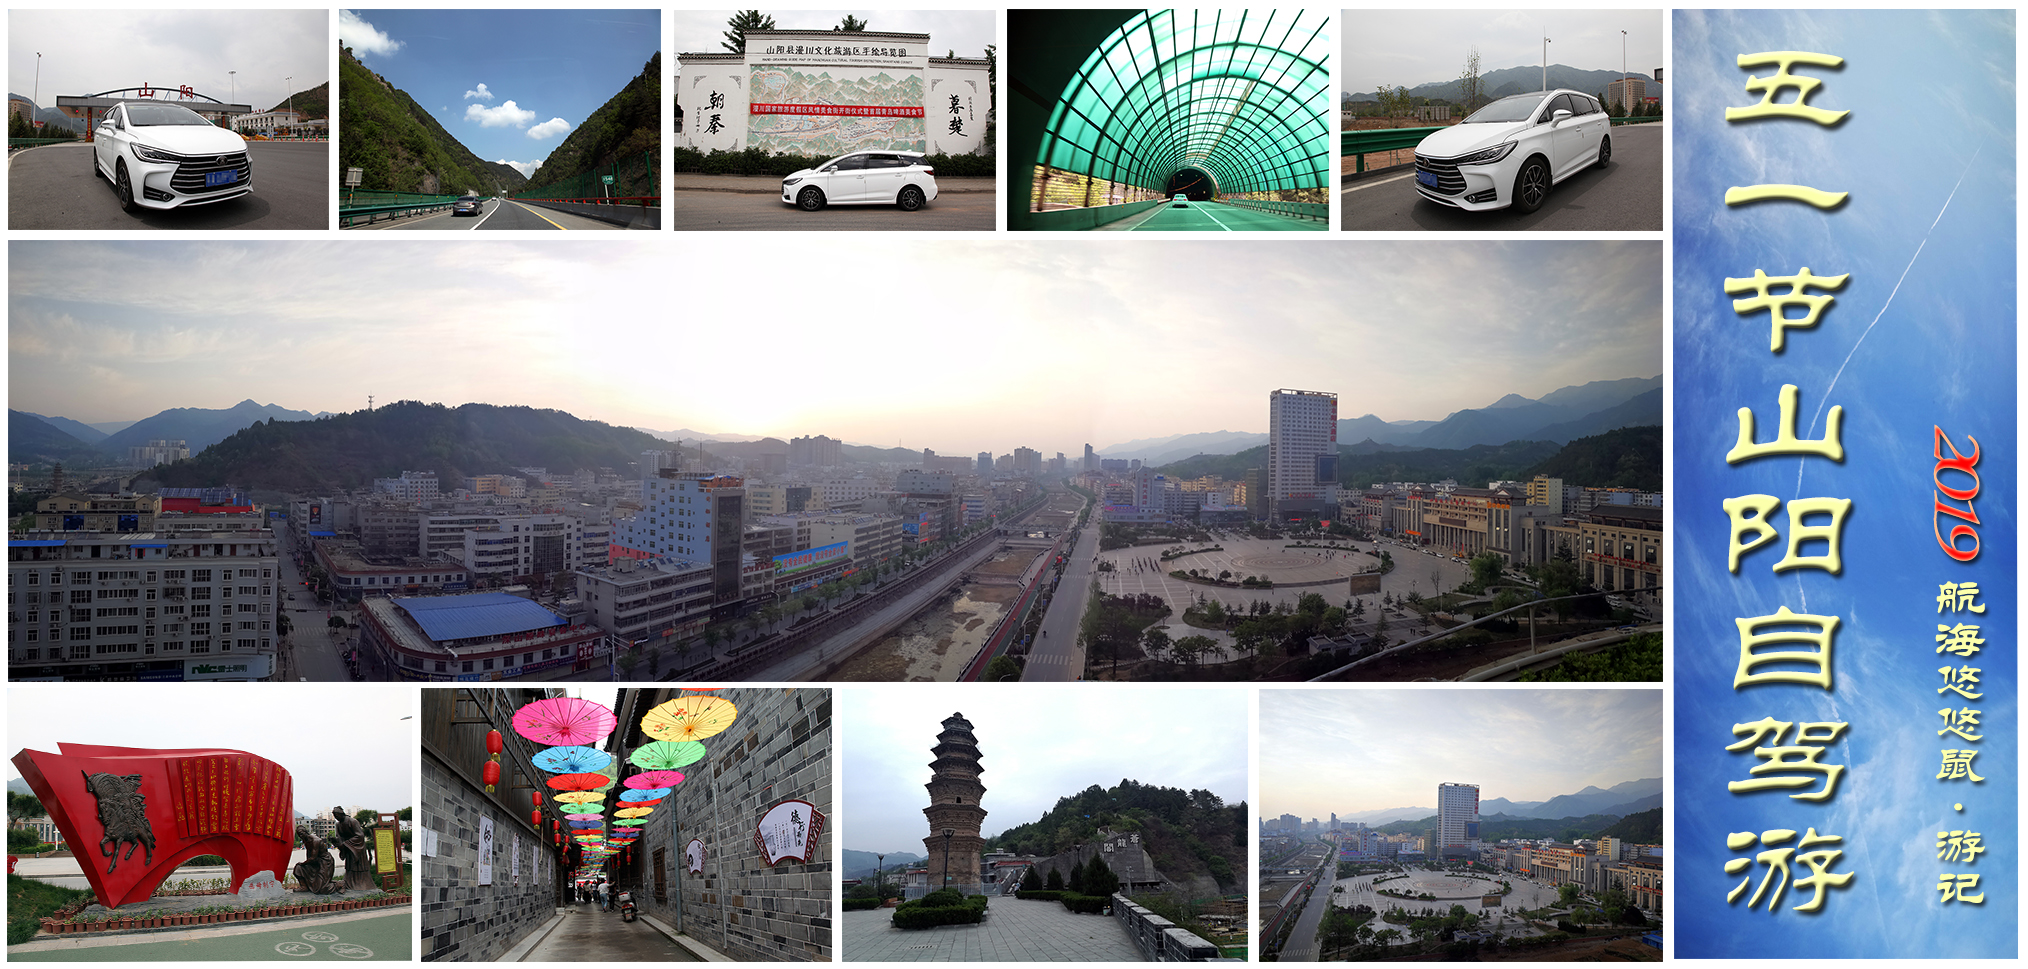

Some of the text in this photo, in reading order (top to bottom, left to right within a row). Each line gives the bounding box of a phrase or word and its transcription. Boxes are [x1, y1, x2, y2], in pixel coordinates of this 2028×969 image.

[138, 81, 193, 100] 山阳
[704, 90, 726, 135] 朝秦
[948, 93, 968, 137] 暮楚
